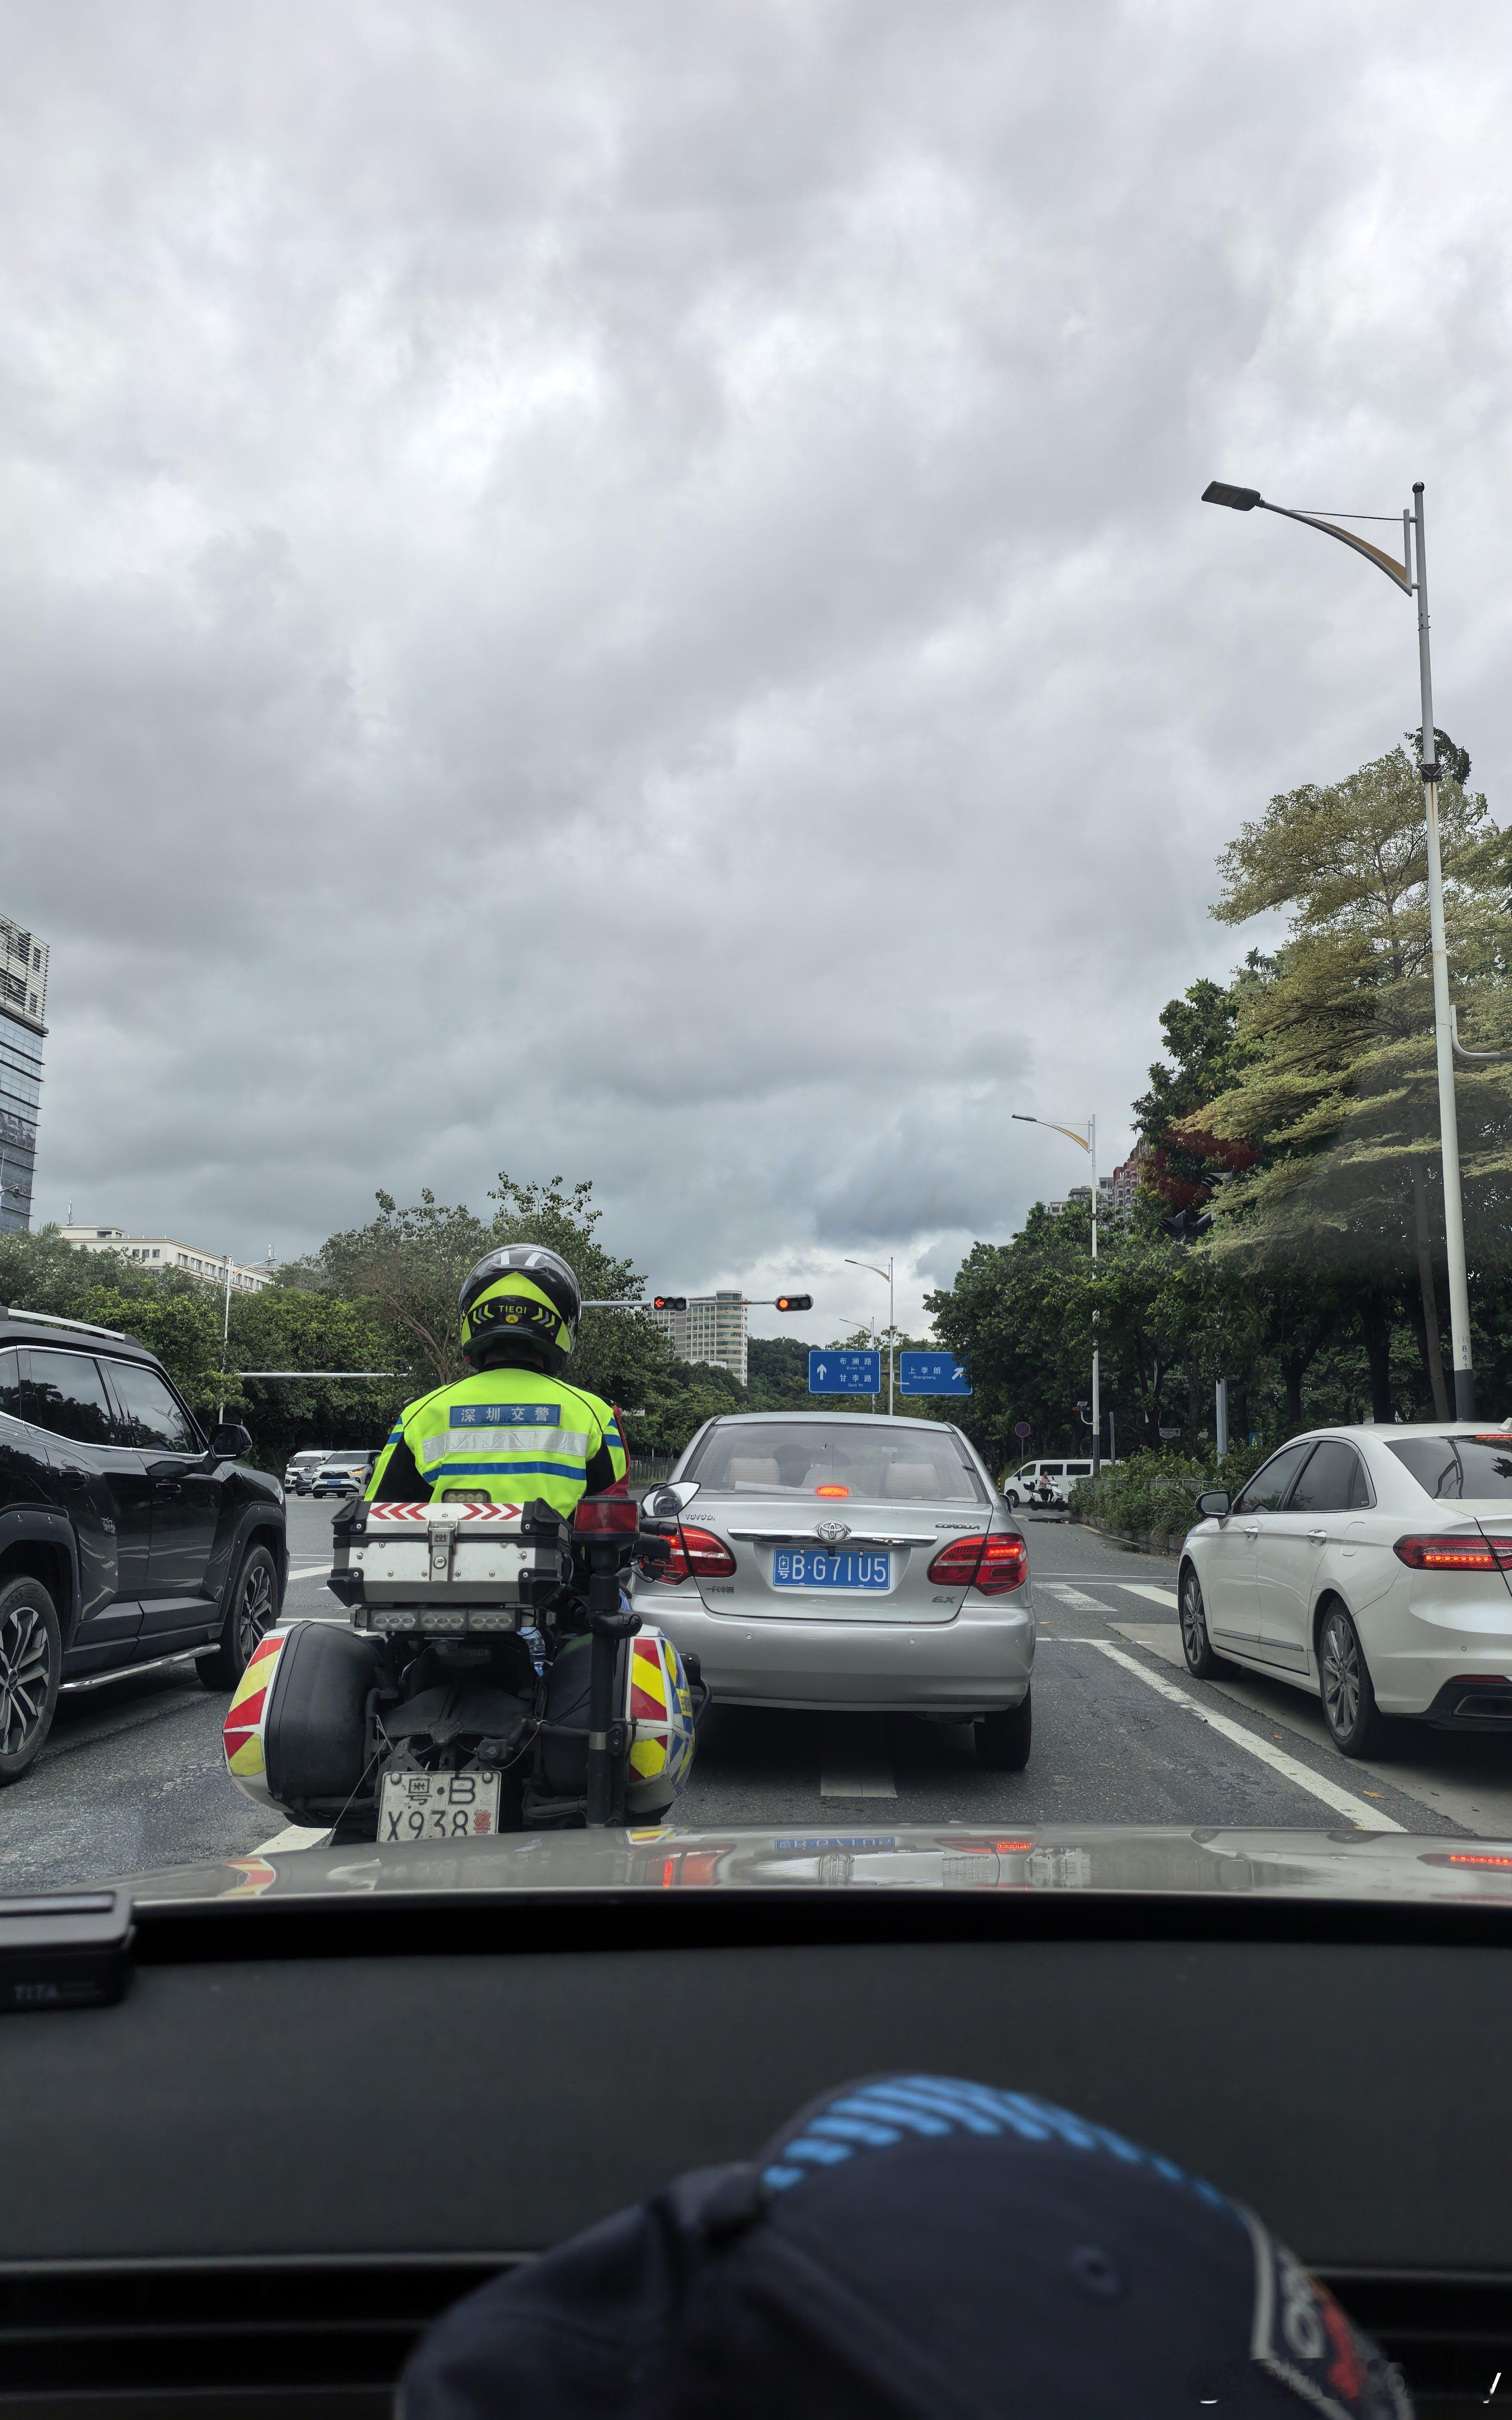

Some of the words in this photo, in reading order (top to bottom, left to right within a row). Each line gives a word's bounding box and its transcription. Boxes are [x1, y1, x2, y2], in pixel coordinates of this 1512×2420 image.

[499, 1305, 527, 1314] TIEQI
[840, 1374, 872, 1382] 甘李路
[461, 1407, 549, 1423] 深圳交警
